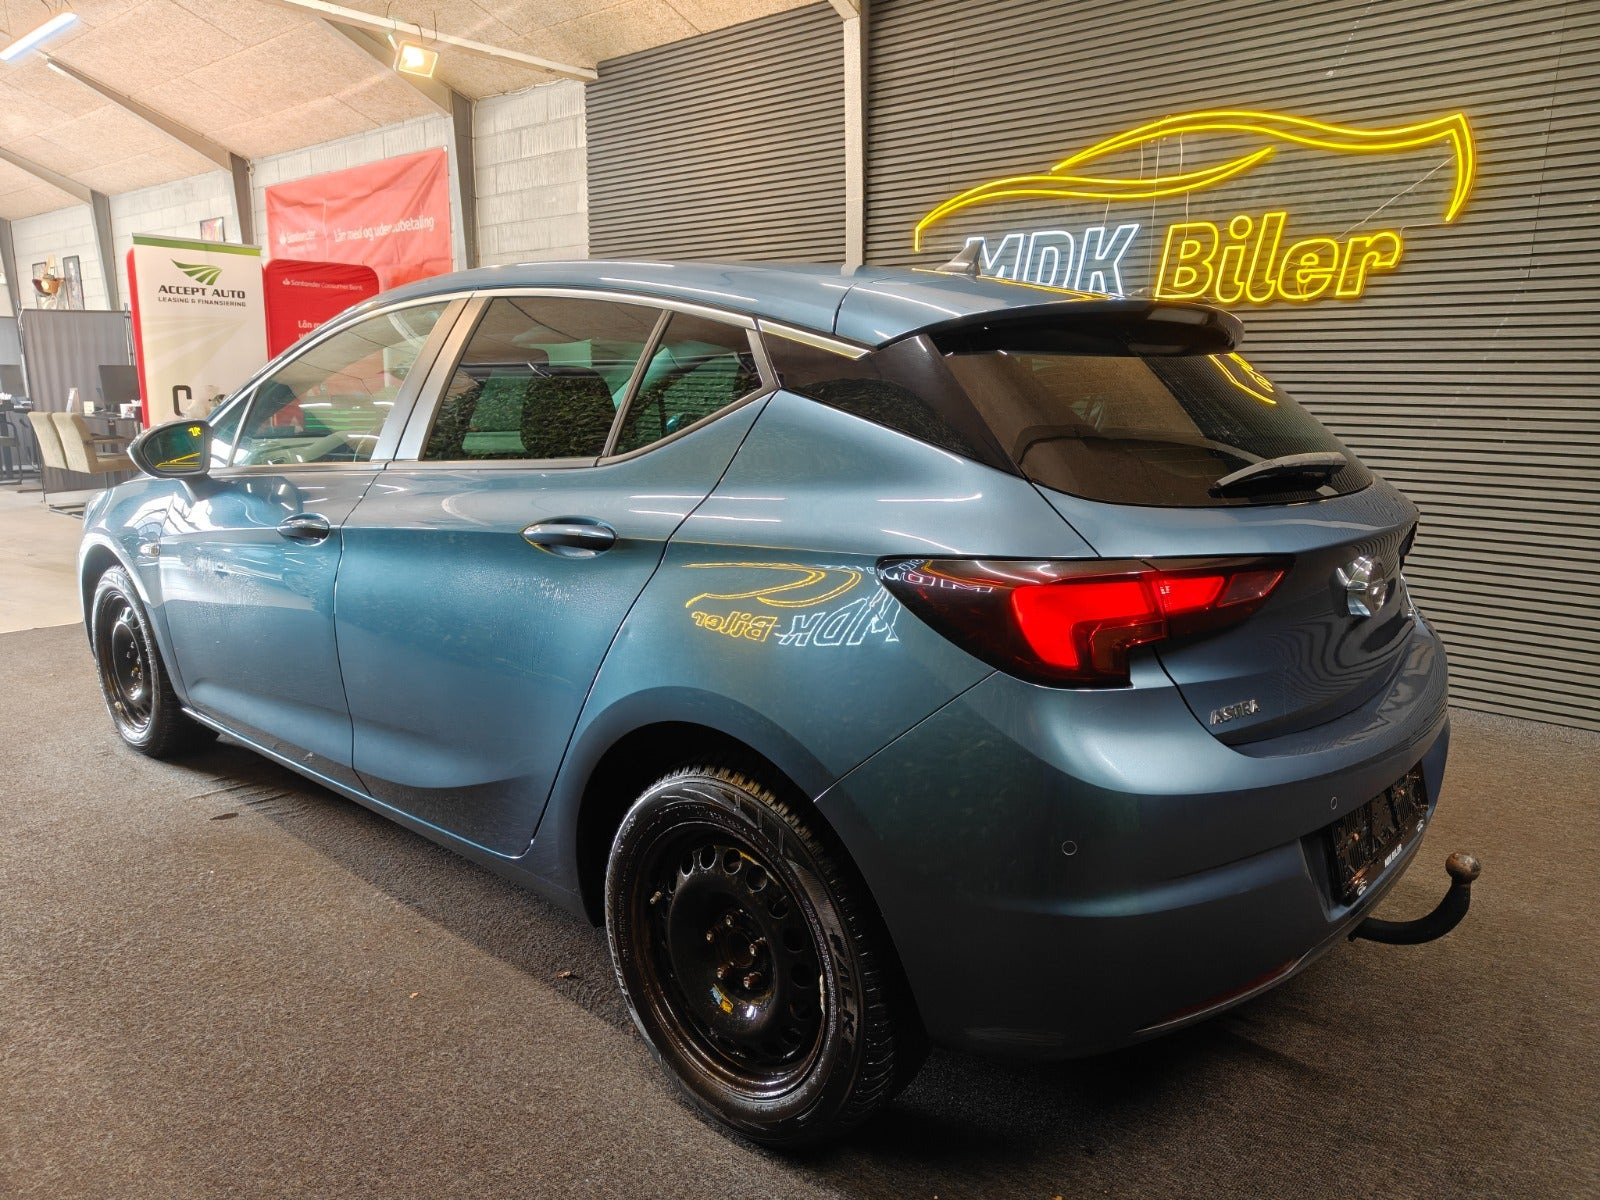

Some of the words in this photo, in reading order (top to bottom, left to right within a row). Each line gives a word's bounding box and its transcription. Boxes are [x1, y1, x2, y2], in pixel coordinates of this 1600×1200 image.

[964, 223, 1141, 298] MDK
[1153, 210, 1404, 304] Biler
[158, 284, 207, 297] ACCEPT
[211, 288, 246, 299] AUTO
[158, 296, 189, 304] LEASING
[197, 298, 247, 308] FINANSIERING
[298, 320, 313, 329] Lån
[1209, 699, 1261, 725] ASTRA
